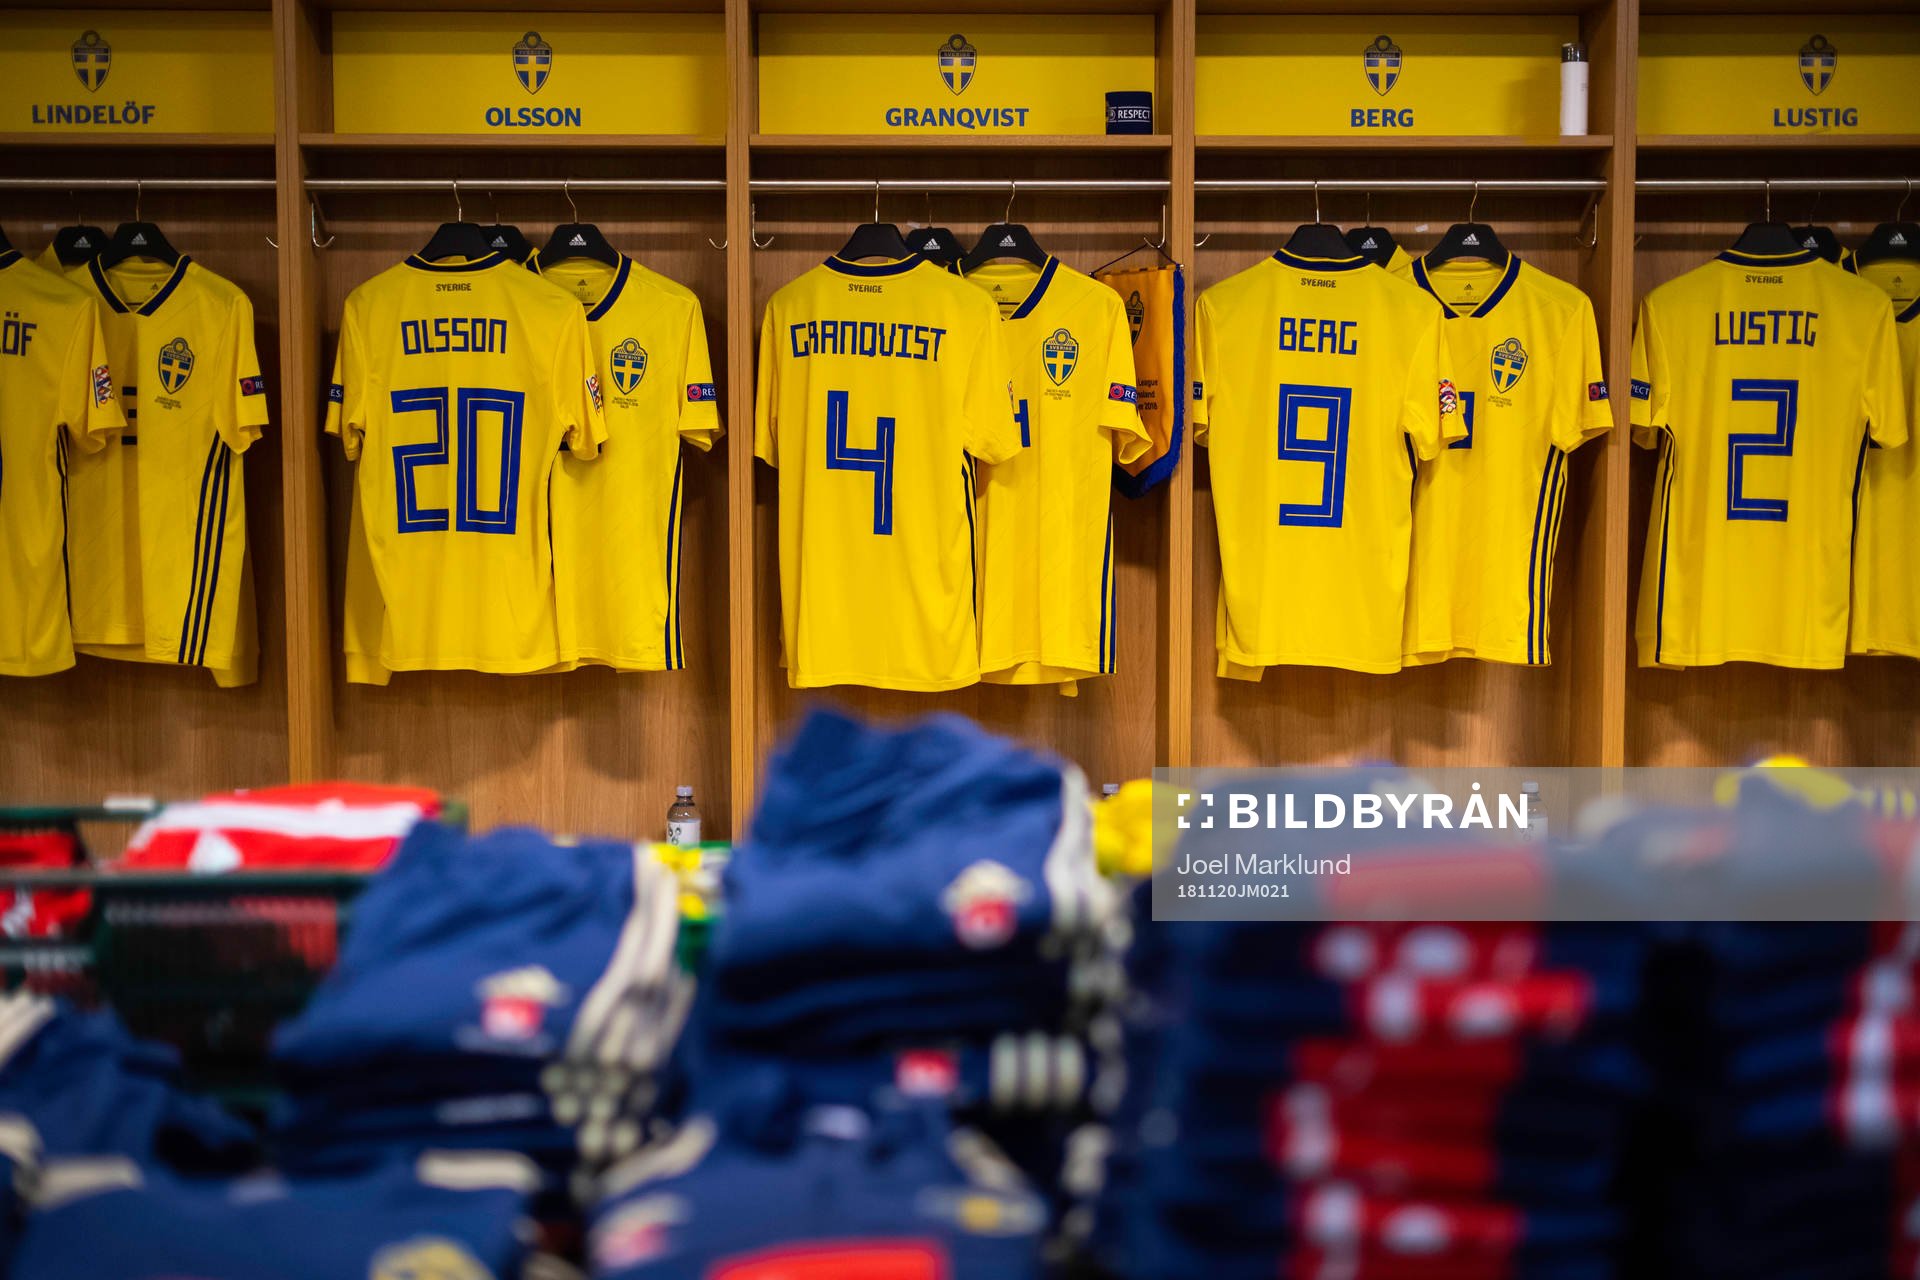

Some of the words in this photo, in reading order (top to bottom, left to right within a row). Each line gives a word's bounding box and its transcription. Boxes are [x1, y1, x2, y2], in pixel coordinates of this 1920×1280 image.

[32, 101, 155, 124] LINDELÖF
[485, 107, 581, 127] OLSSON
[885, 107, 1029, 129] GRANQVIST
[1117, 109, 1151, 119] RESPECT
[1350, 108, 1414, 127] BERG
[1773, 108, 1858, 127] LUSTIG
[436, 283, 472, 292] SVERIGE
[848, 284, 883, 293] SVERIGE
[1301, 278, 1337, 288] SVERIGE
[1745, 275, 1783, 284] SVERIGE
[401, 318, 507, 355] OLSSON
[1279, 317, 1357, 355] BERG
[1715, 310, 1819, 347] LUSTIG
[790, 320, 947, 362] GRANQVIST
[390, 386, 525, 535] 20
[1278, 383, 1352, 528] 9
[1727, 379, 1799, 522] 2
[826, 390, 896, 535] 4
